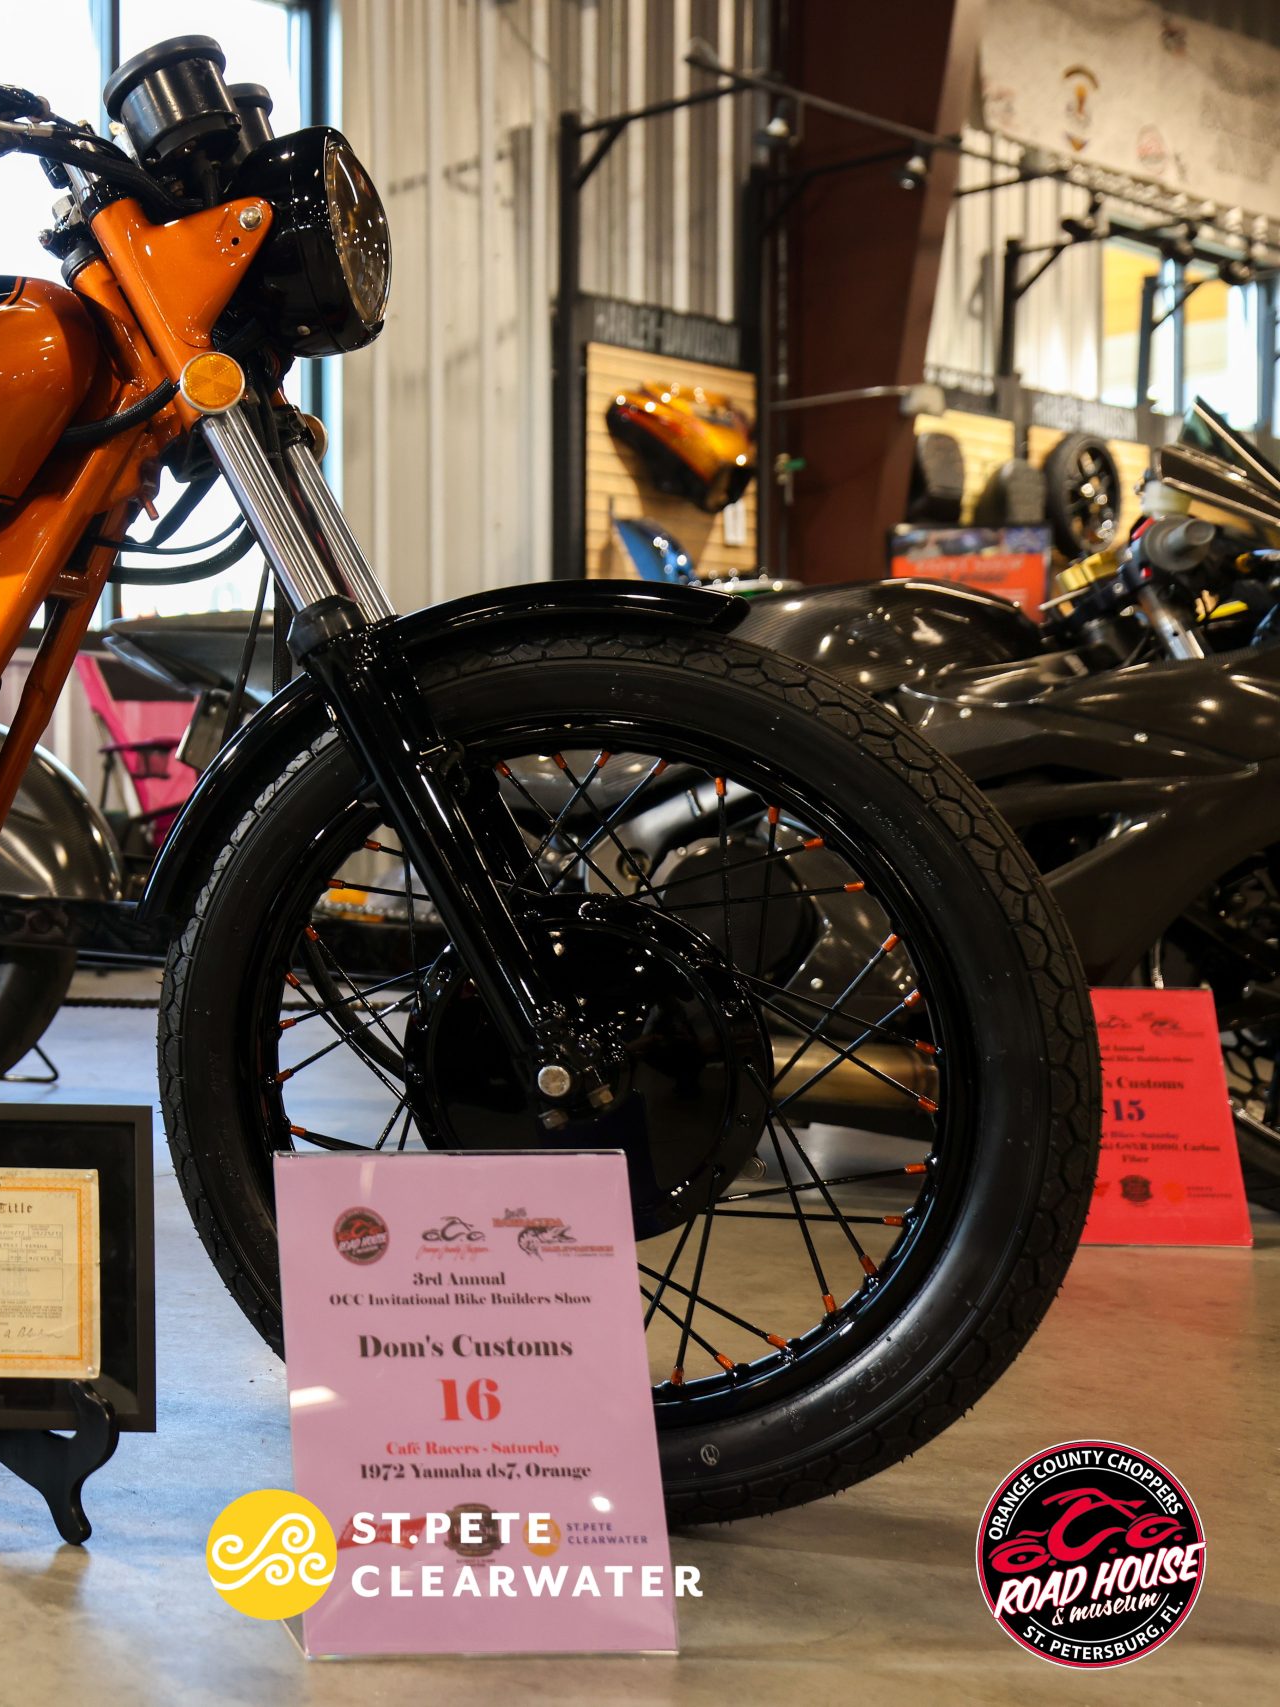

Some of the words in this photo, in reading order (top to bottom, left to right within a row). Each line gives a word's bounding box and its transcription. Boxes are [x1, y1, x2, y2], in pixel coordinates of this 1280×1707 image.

[1117, 1076, 1184, 1090] Customs
[1112, 1099, 1145, 1121] 15
[413, 1272, 443, 1286] 3rd
[447, 1271, 506, 1286] Annual
[329, 1293, 364, 1306] OCC
[368, 1292, 450, 1305] Invitational
[455, 1292, 487, 1305] Bike
[491, 1292, 551, 1305] Builders
[554, 1292, 592, 1305] Show
[358, 1334, 443, 1358] Dom's
[452, 1333, 573, 1358] Customs
[440, 1378, 501, 1422] 16
[386, 1440, 420, 1456] Café
[425, 1441, 480, 1456] Racers
[491, 1440, 561, 1457] Saturday
[360, 1463, 405, 1480] 1972
[409, 1463, 482, 1479] Yamaha
[524, 1462, 592, 1480] Orange
[567, 1522, 613, 1532] ST.PETE
[567, 1534, 649, 1545] CLEARWATER
